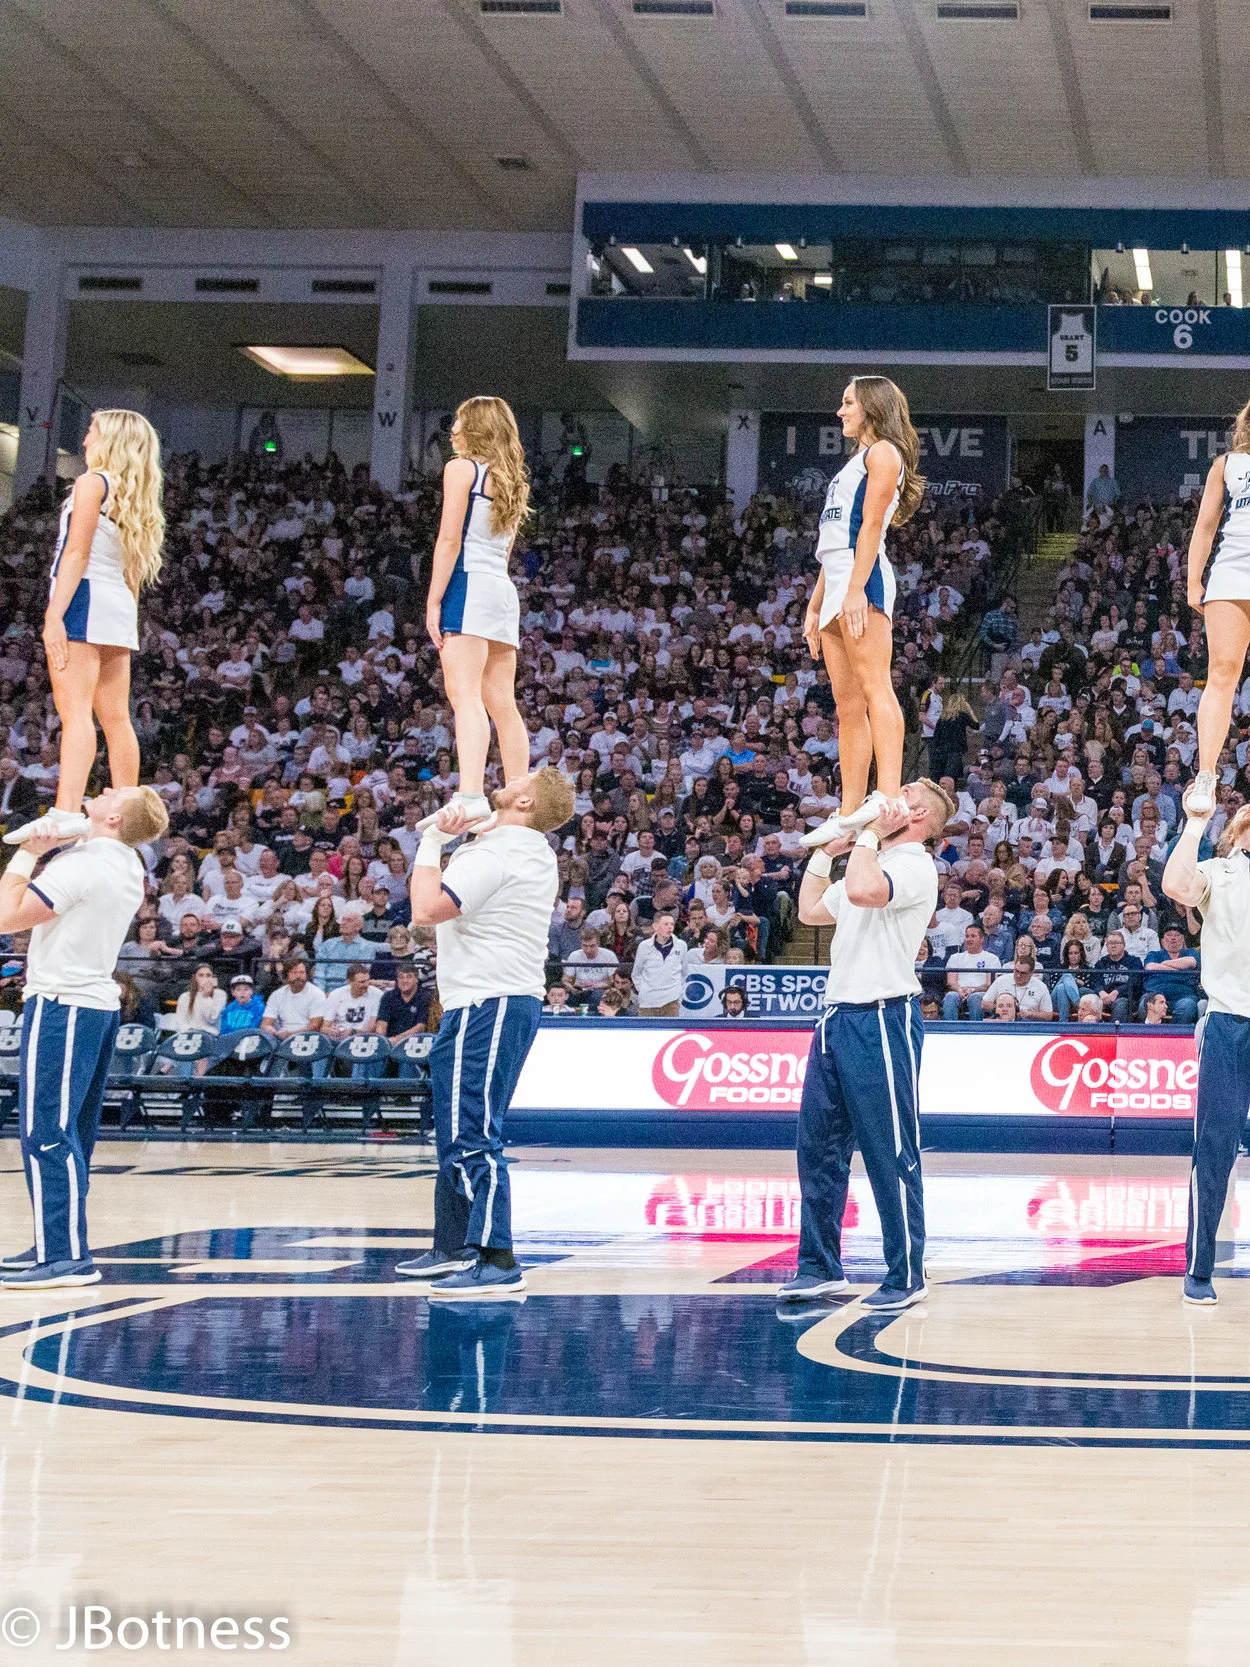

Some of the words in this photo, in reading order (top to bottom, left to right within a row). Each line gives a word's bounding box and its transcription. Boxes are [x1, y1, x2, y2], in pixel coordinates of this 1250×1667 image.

[1155, 310, 1212, 324] COOK
[1173, 325, 1193, 349] 6
[1065, 345, 1079, 362] 5
[378, 412, 397, 427] W
[737, 415, 750, 430] X
[1093, 420, 1107, 436] A
[786, 426, 797, 454] I
[1090, 1092, 1193, 1110] FOODS
